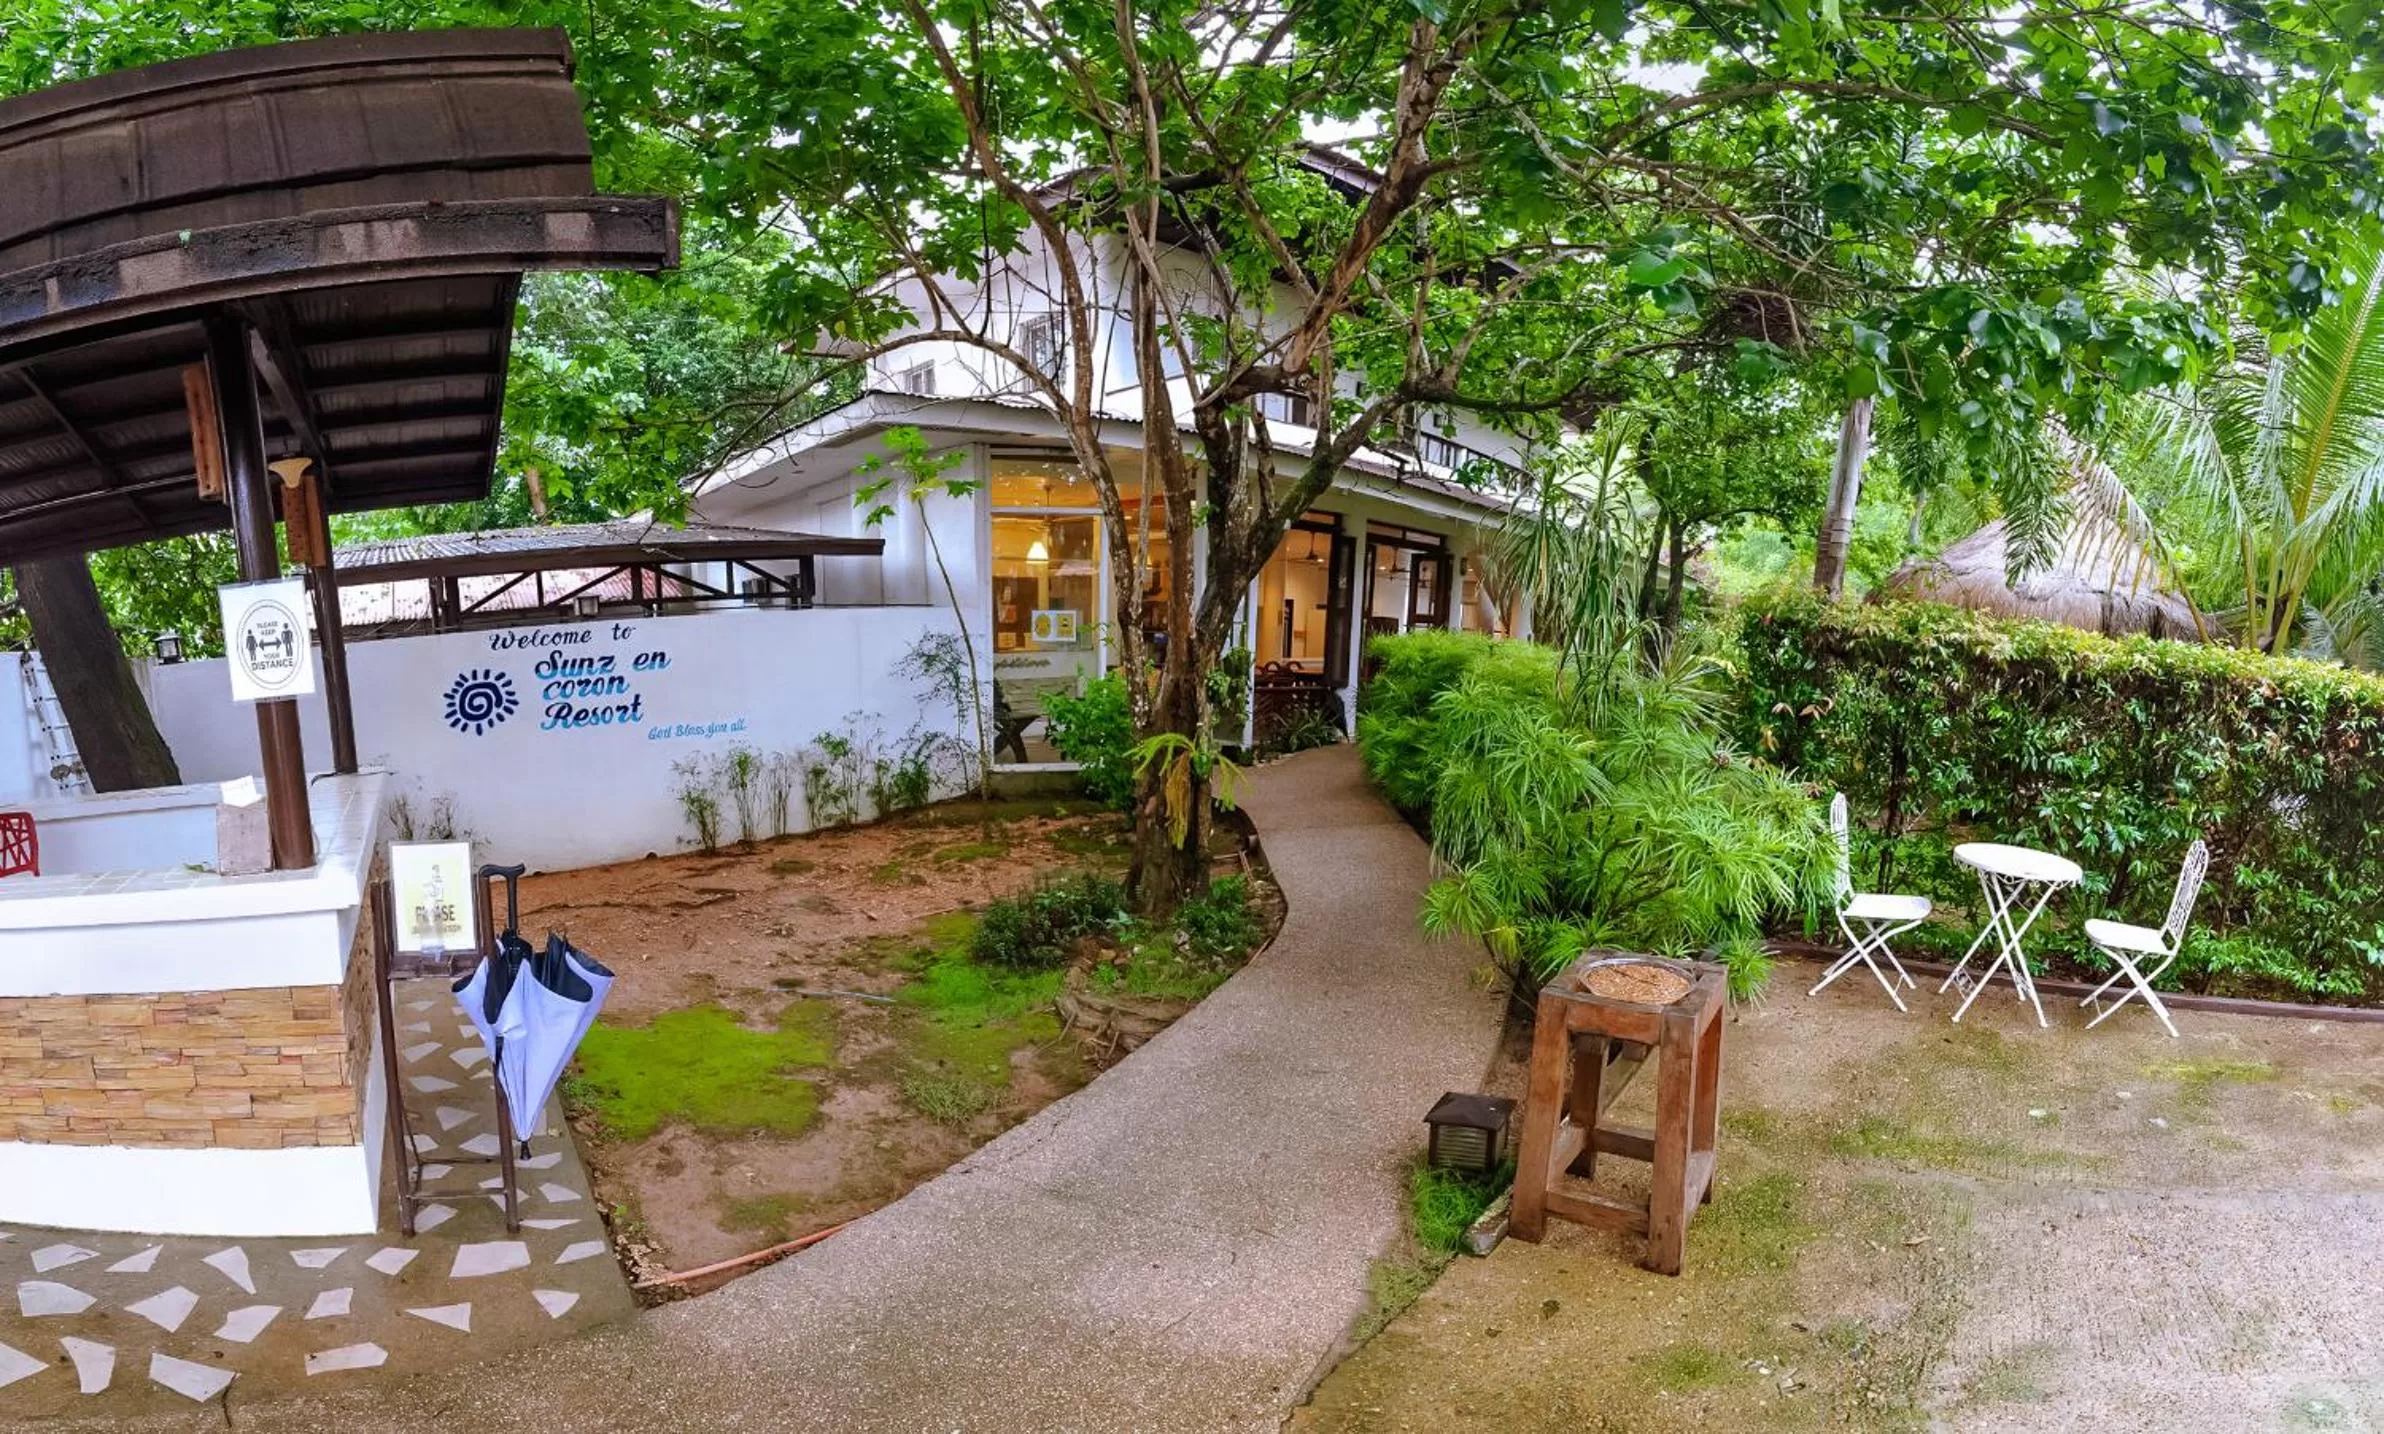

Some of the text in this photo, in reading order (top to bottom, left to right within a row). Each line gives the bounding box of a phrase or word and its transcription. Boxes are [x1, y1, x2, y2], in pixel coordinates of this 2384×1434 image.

[256, 621, 278, 629] PLEASE
[490, 623, 636, 650] Welcome to
[251, 658, 293, 671] DISTANCE
[534, 650, 671, 679] Sunz en
[540, 693, 644, 730] Resort
[648, 725, 672, 740] God
[675, 723, 705, 737] Bless
[705, 721, 727, 738] you
